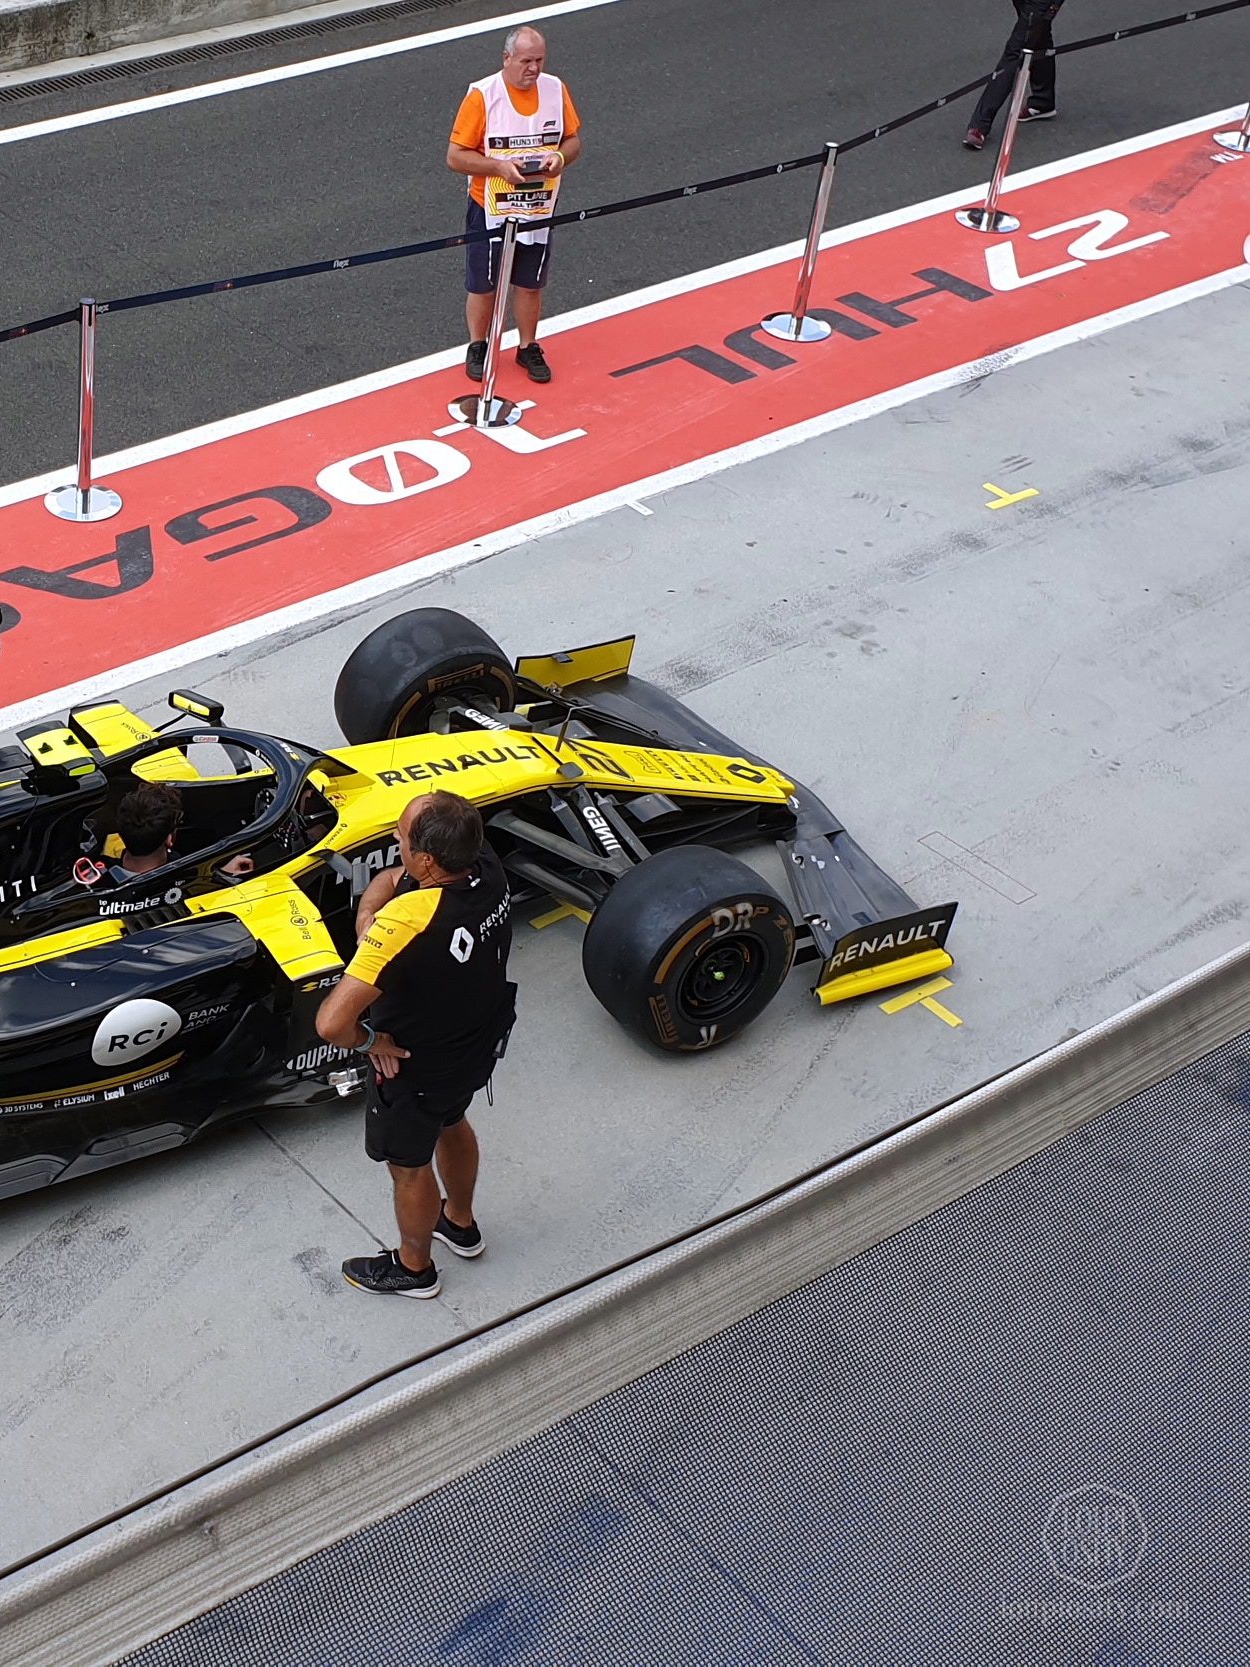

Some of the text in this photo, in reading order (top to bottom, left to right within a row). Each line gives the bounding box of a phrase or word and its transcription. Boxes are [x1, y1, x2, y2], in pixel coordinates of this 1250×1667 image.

[507, 191, 548, 201] PIT LANE
[608, 209, 1171, 385] 27 HUL
[315, 399, 588, 506] 10
[376, 745, 541, 787] RENAULT
[100, 897, 161, 916] ultimate
[299, 927, 312, 940] Bell
[829, 920, 946, 973] RENAULT
[188, 1003, 231, 1021] BANK
[649, 993, 679, 1044] PIRELLI
[63, 1094, 95, 1106] ELYSIUM
[104, 1086, 126, 1101] ixell
[133, 1071, 170, 1091] HECHTER
